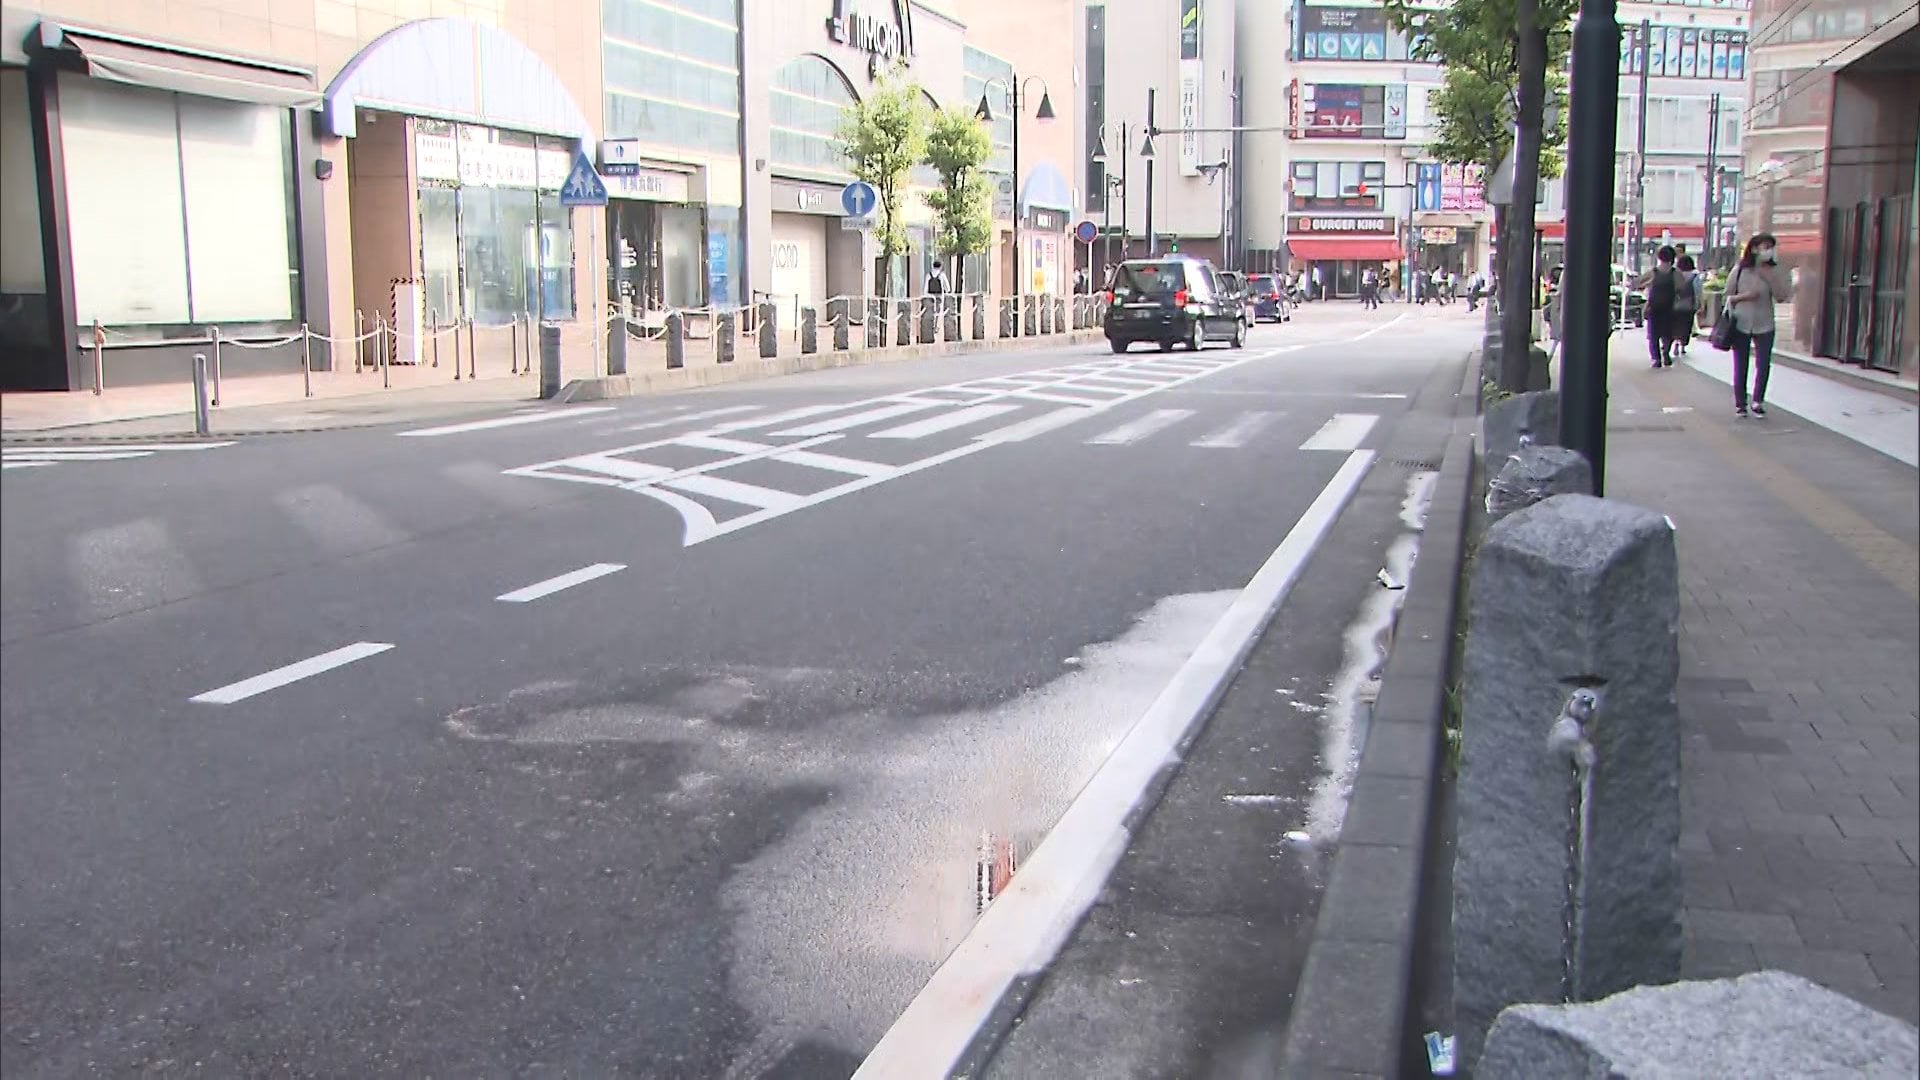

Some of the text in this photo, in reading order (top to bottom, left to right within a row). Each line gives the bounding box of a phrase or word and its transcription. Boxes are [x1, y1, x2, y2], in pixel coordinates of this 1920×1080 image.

[1305, 36, 1381, 57] NOVA
[1312, 219, 1385, 231] BURGER KING
